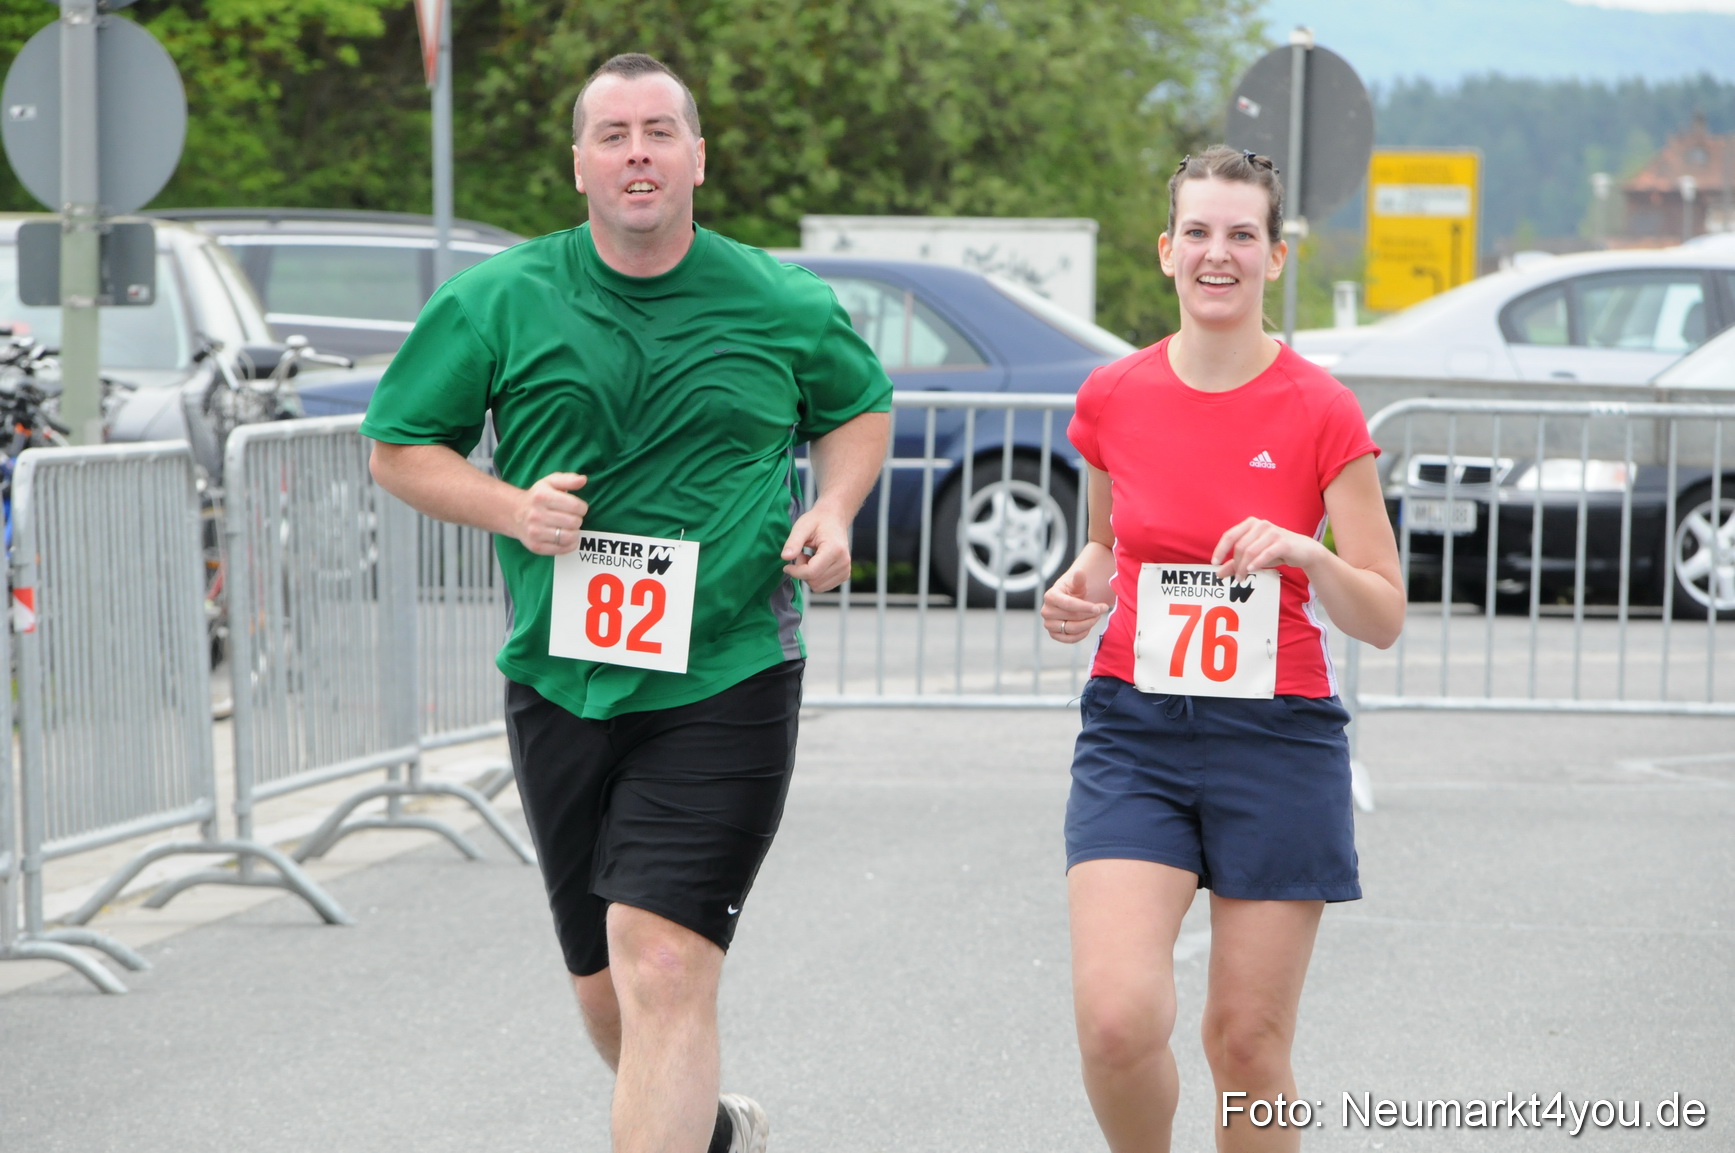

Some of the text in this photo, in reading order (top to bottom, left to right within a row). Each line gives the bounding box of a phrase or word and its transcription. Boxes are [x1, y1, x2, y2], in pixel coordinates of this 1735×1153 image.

[1249, 460, 1276, 469] adidas
[579, 537, 643, 557] MEYER
[579, 552, 643, 569] WERBUNG
[1161, 570, 1224, 586] MEYER
[1161, 586, 1225, 598] WERBUNG
[585, 573, 666, 654] 82
[1169, 604, 1239, 682] 76
